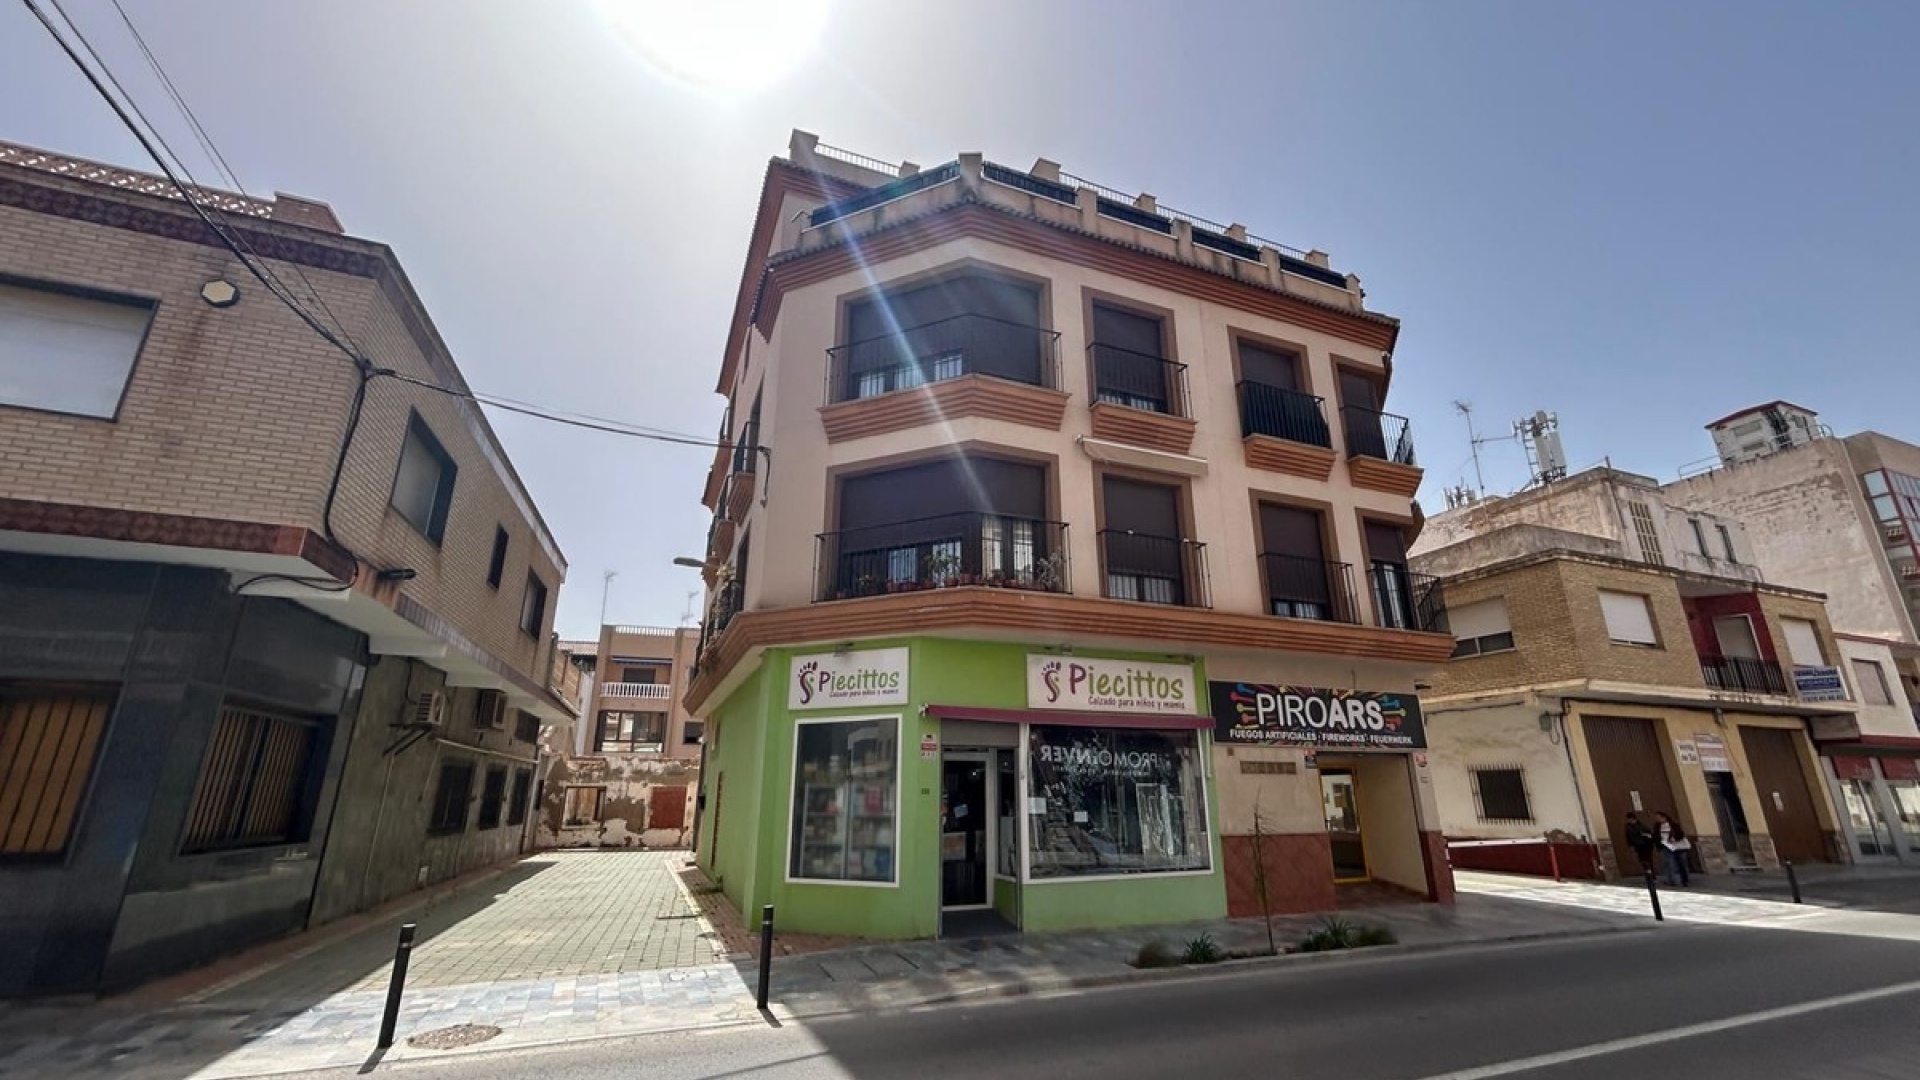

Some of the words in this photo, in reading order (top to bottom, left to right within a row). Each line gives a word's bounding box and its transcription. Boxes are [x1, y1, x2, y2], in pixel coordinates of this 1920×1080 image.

[819, 668, 900, 692] Piecittos
[1069, 663, 1184, 699] Piecittos
[1087, 696, 1116, 706] Calzado
[1118, 698, 1134, 708] para
[1256, 693, 1385, 730] PIROARS
[1229, 728, 1264, 739] FUEGOS
[1265, 730, 1318, 741] ARTIFICIALES
